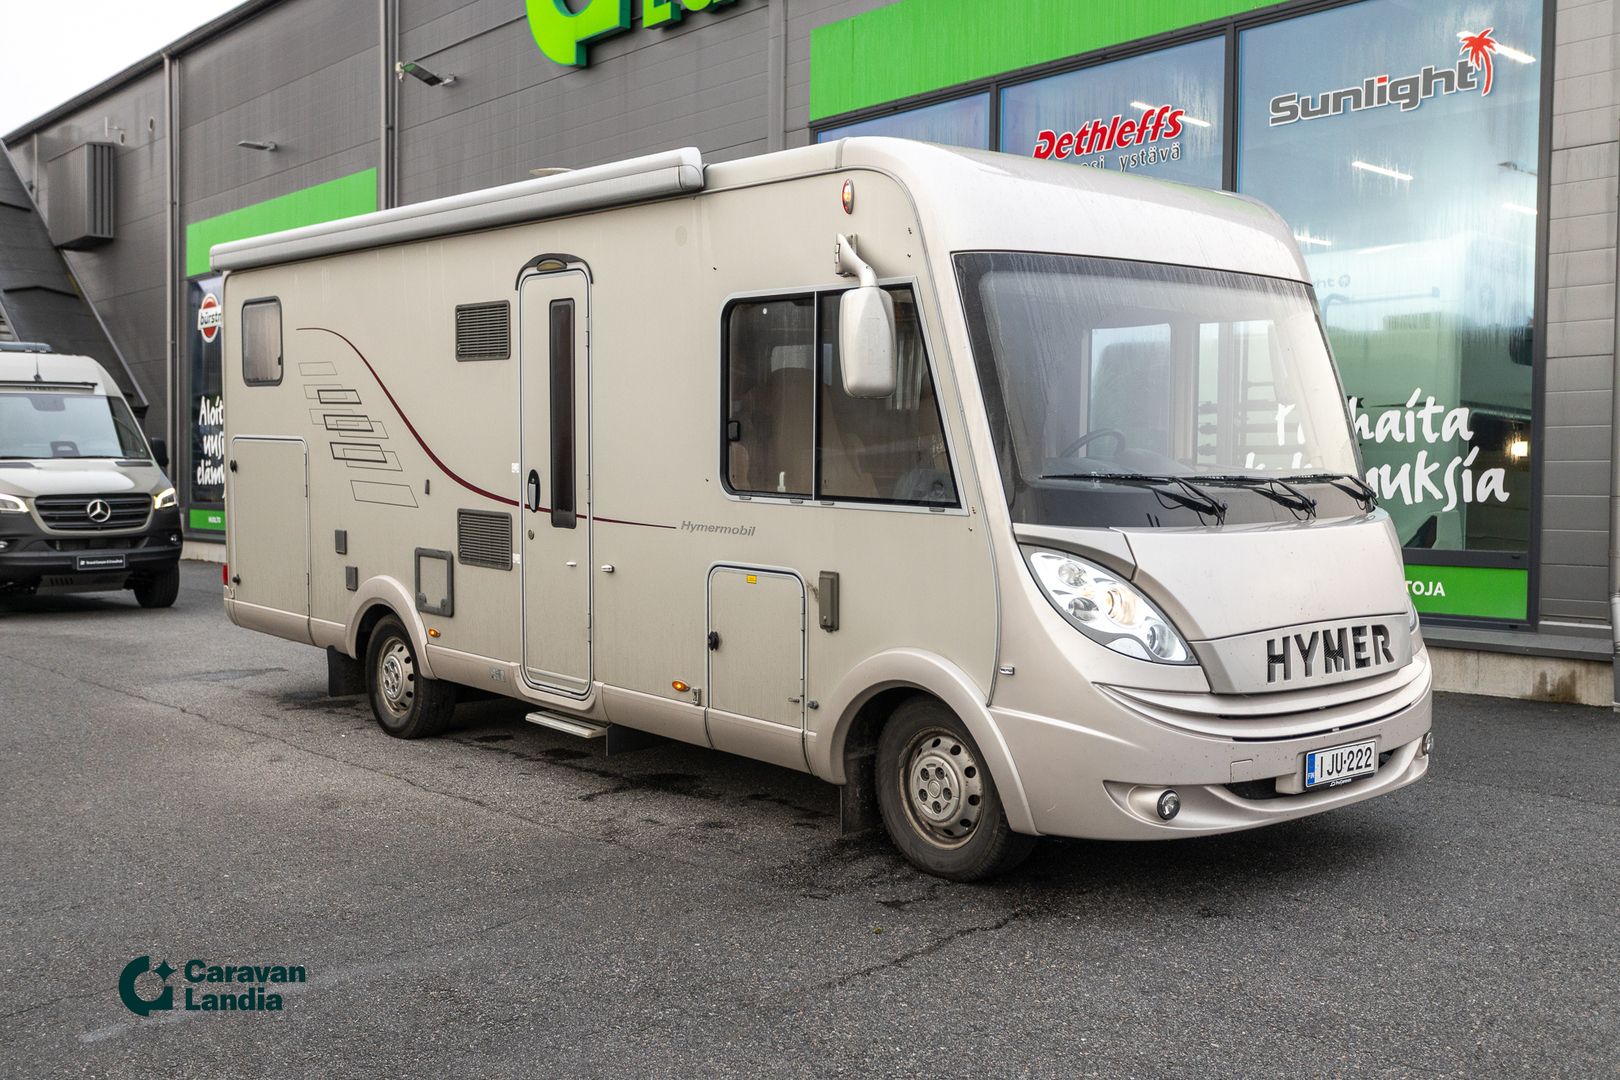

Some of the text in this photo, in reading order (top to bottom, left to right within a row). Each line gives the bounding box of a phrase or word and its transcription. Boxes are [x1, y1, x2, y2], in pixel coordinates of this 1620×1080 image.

[1269, 59, 1477, 127] Sunlight
[1033, 104, 1185, 160] Dethleffs
[1119, 142, 1181, 173] ystävä
[680, 519, 756, 537] Hymermobil
[1266, 624, 1395, 684] HYMER
